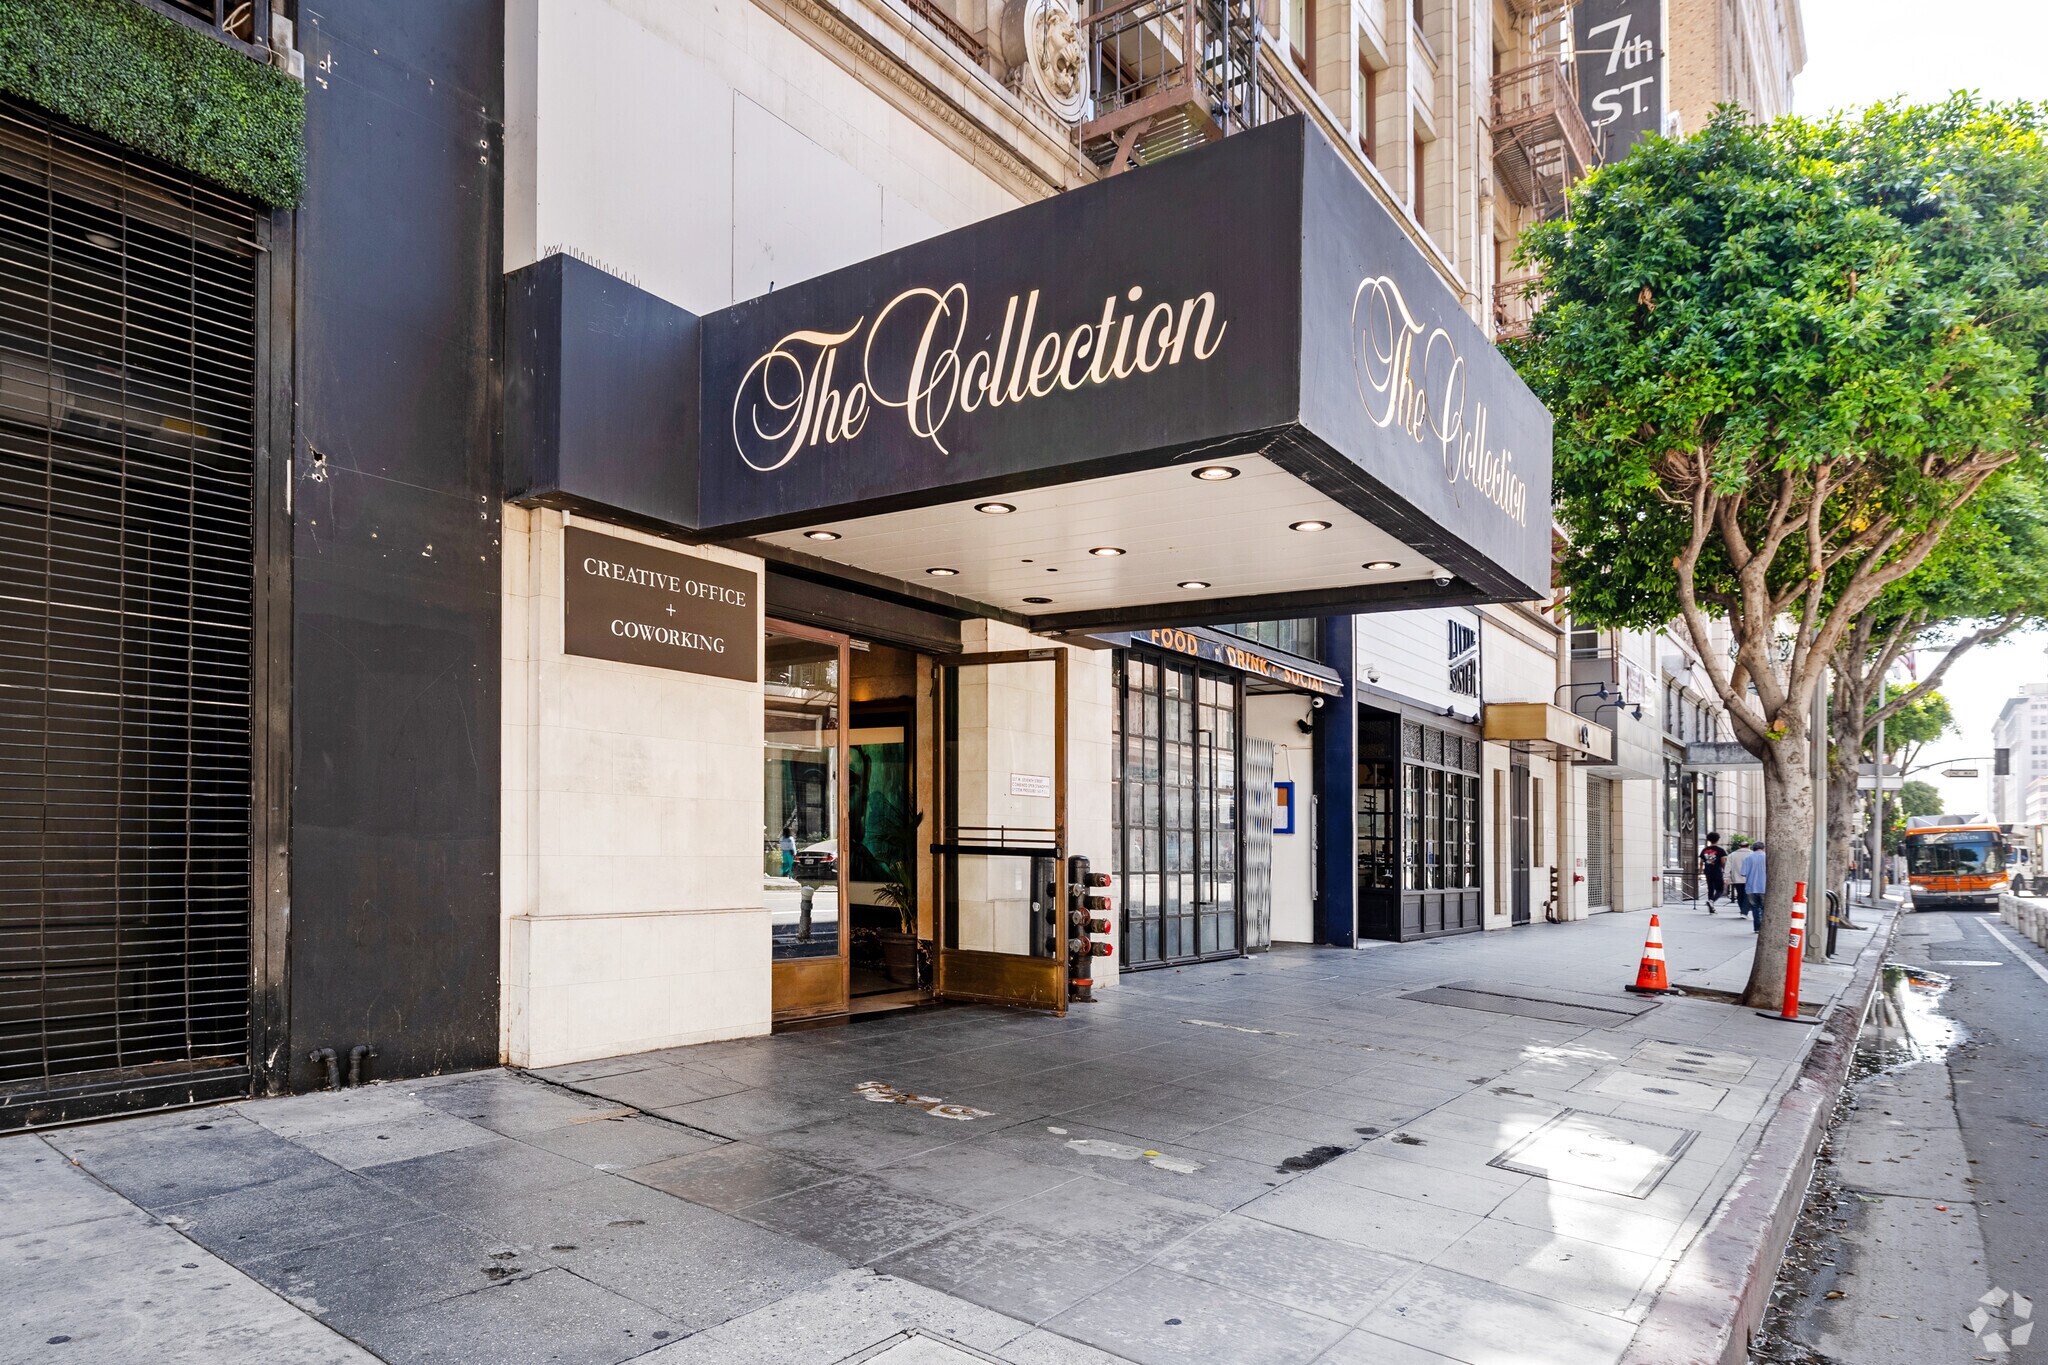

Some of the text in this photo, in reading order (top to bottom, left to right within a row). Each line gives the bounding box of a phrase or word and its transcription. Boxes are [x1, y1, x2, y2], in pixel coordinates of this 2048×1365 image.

[1588, 14, 1653, 76] 7th
[733, 282, 1228, 472] The Collection
[1352, 276, 1526, 528] The Collection
[583, 557, 747, 607] CREATIVE OFFICE
[611, 619, 725, 654] COWORKING
[1151, 628, 1198, 656] FOOD
[1227, 646, 1268, 676] DRINK
